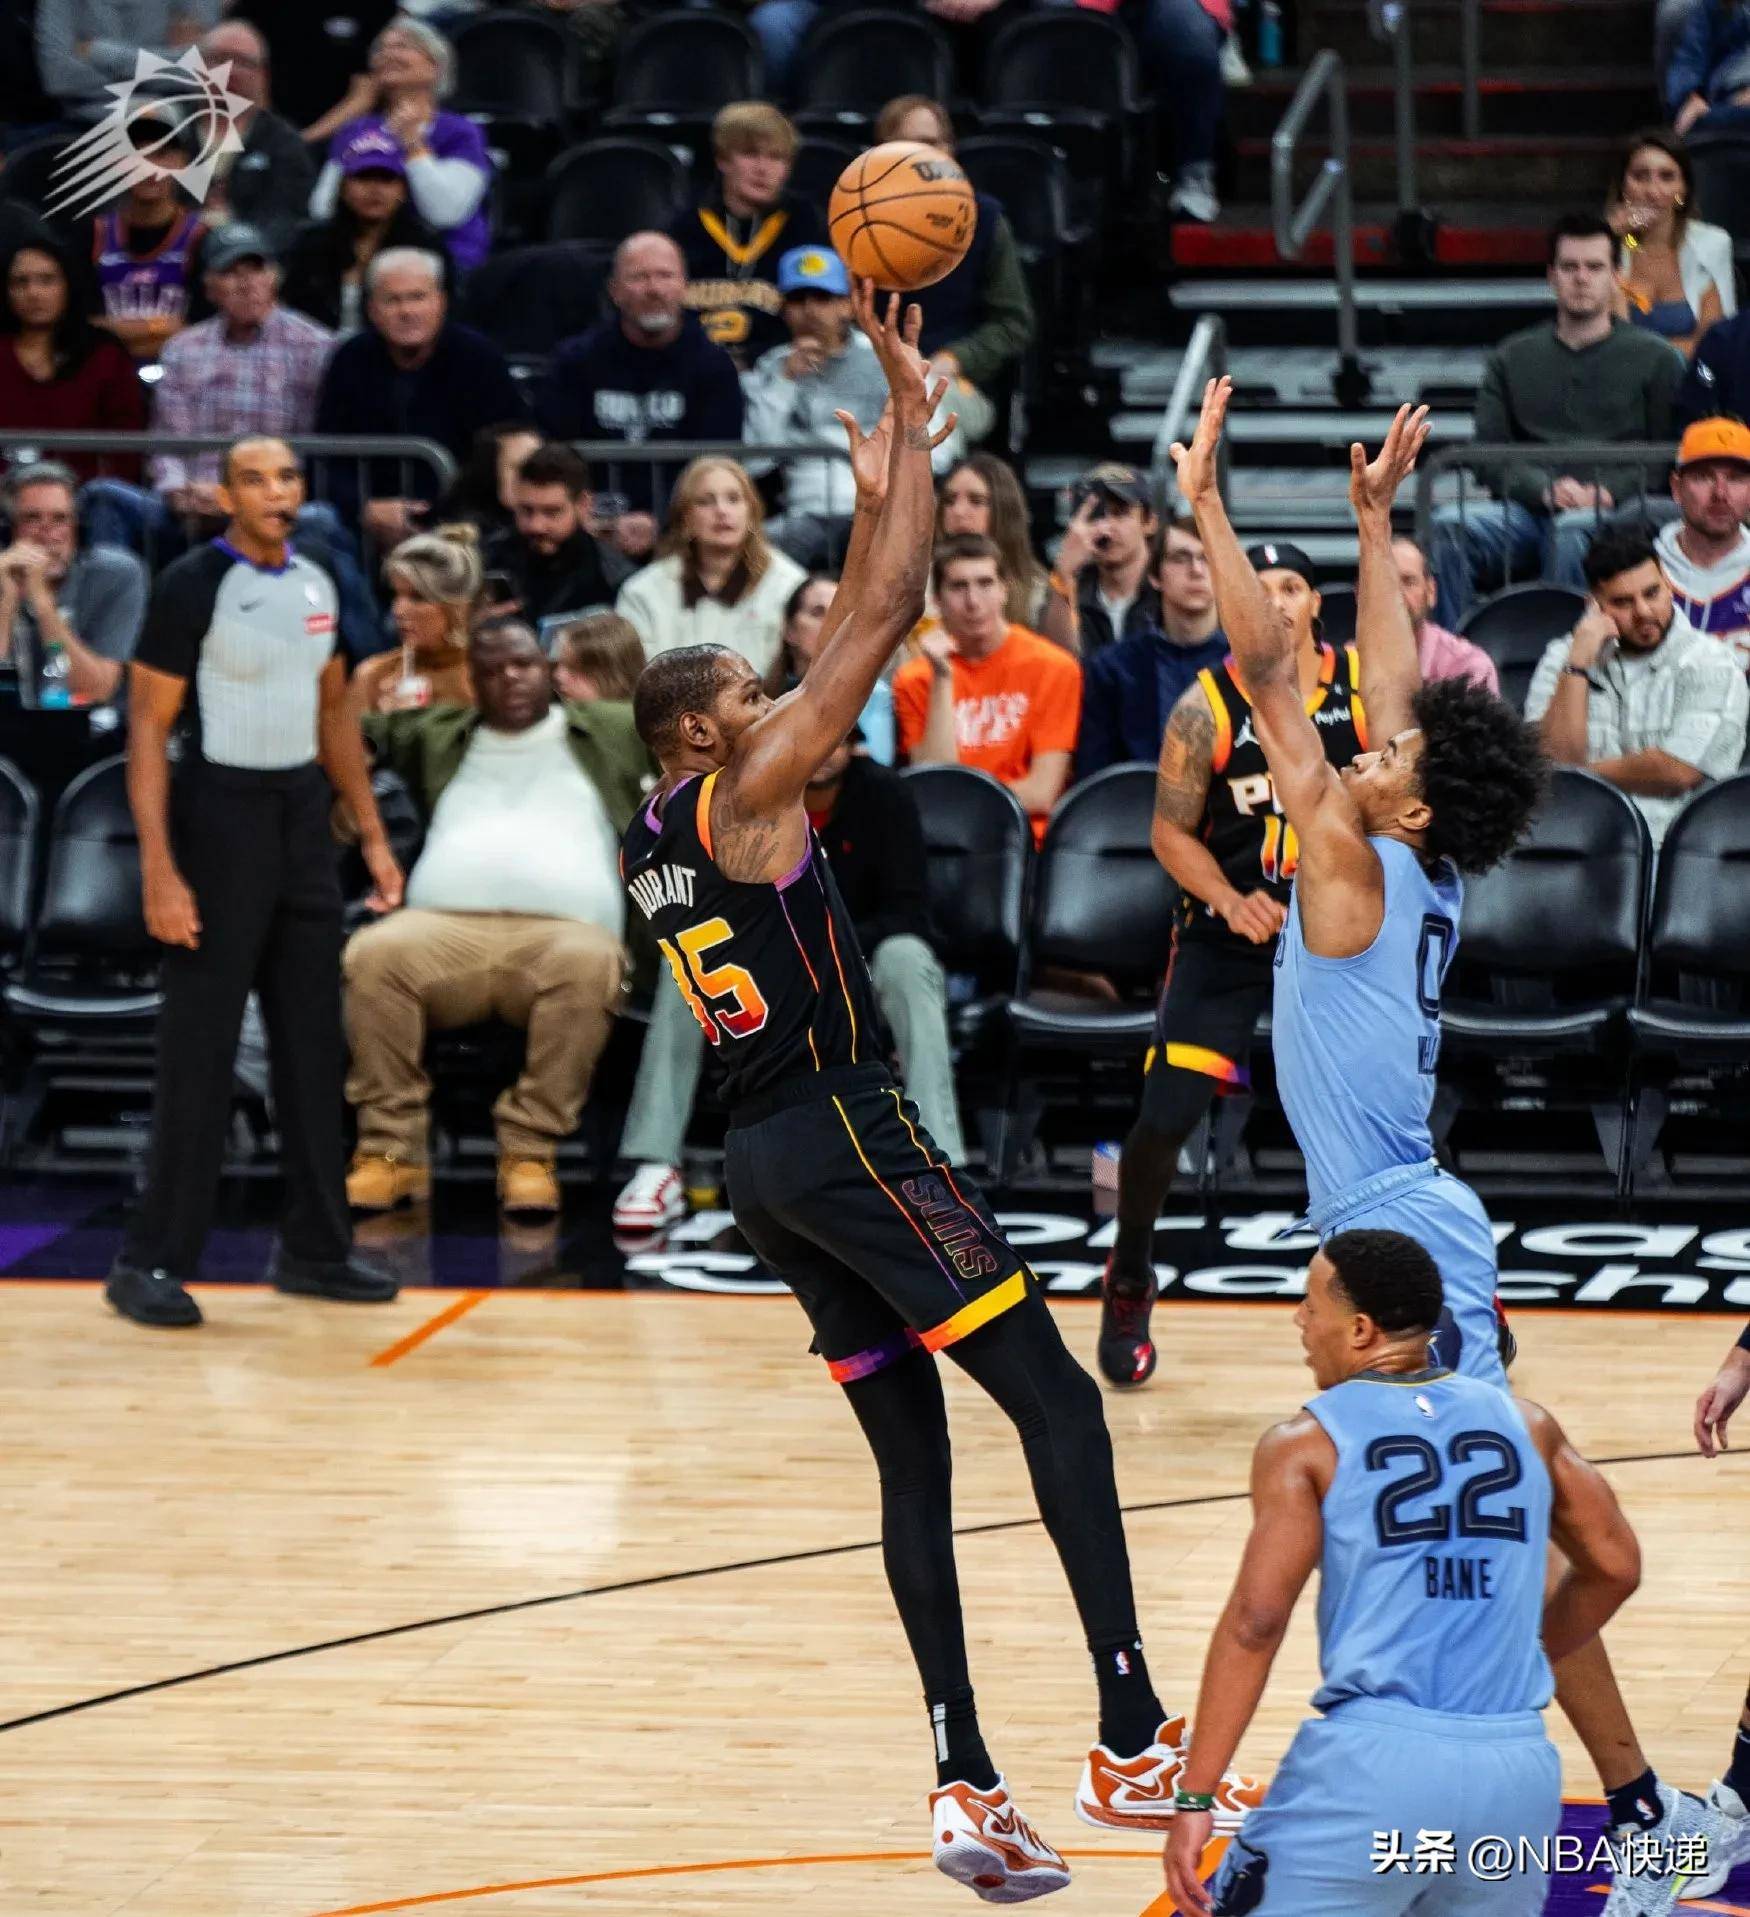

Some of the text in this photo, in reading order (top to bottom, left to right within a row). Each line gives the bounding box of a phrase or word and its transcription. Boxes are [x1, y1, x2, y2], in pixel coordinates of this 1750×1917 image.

[628, 864, 697, 920] DURANT
[902, 1174, 998, 1279] SUNS
[1365, 1430, 1528, 1548] 22
[1424, 1556, 1494, 1600] BANE
